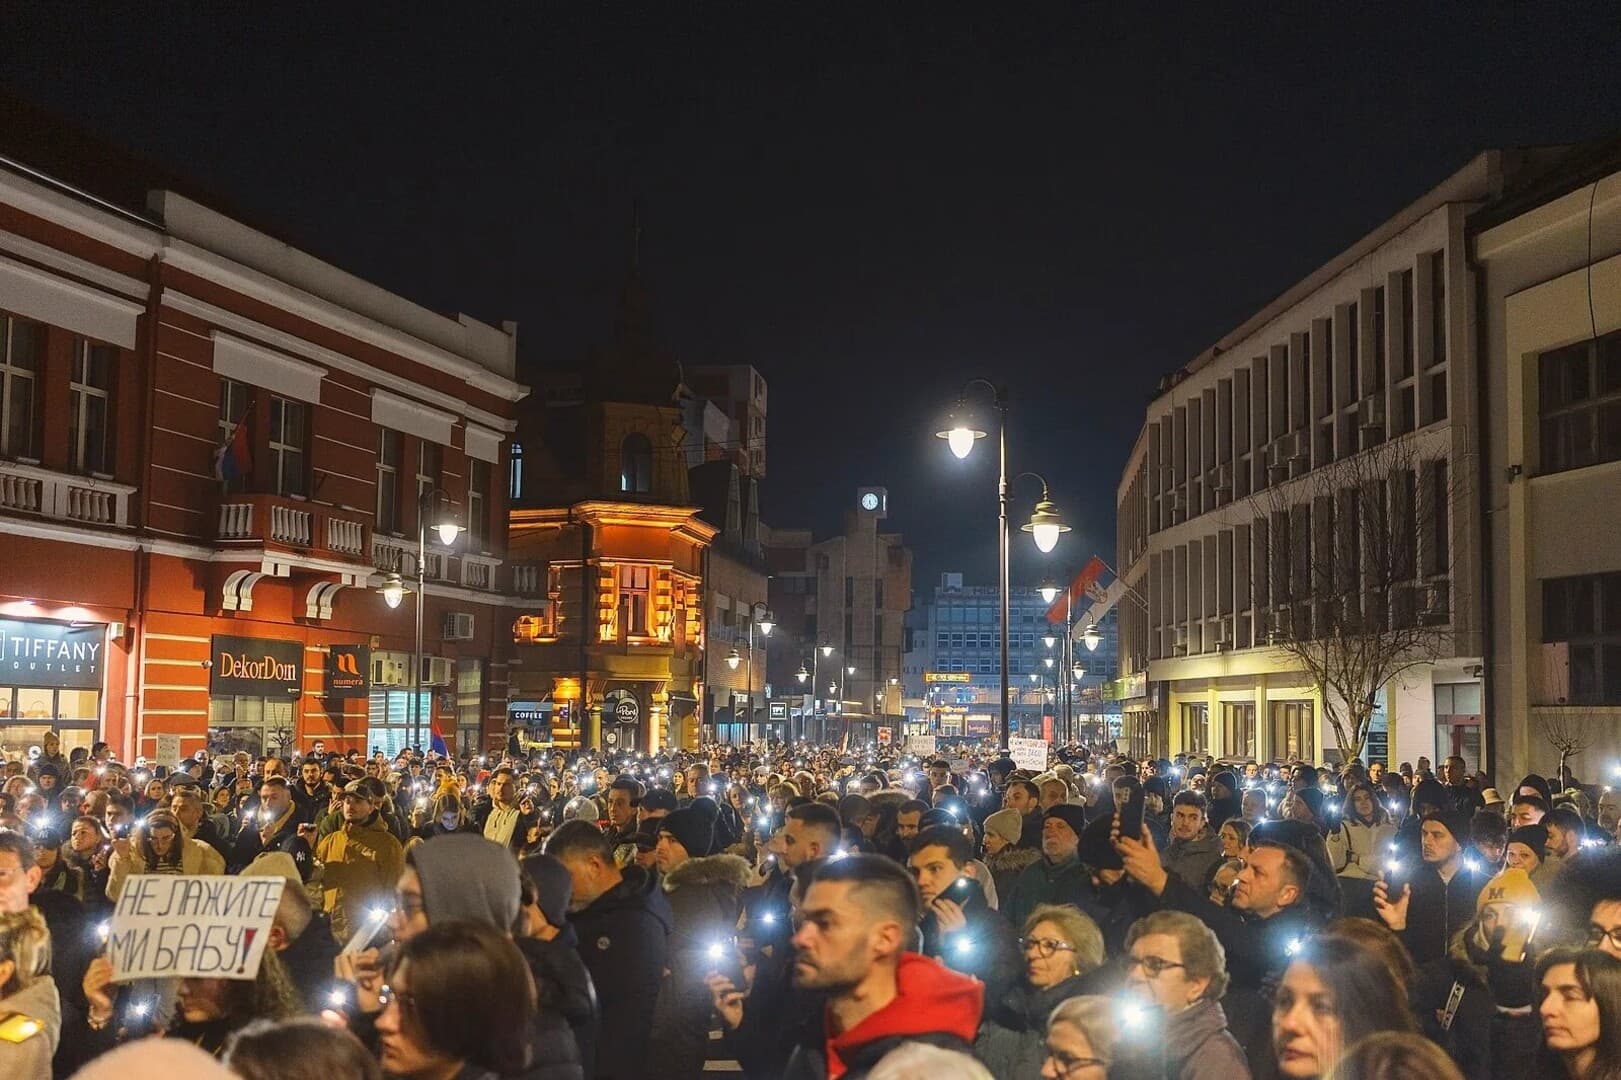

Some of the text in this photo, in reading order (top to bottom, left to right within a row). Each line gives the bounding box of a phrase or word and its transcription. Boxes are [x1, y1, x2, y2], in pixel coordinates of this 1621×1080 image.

[11, 637, 100, 660] TIFFANY
[13, 661, 95, 673] OUTLET
[220, 652, 297, 681] DekorDom
[118, 879, 282, 918] НЕ ЛАЖИТЕ
[111, 923, 258, 974] МИ БАБУ!
